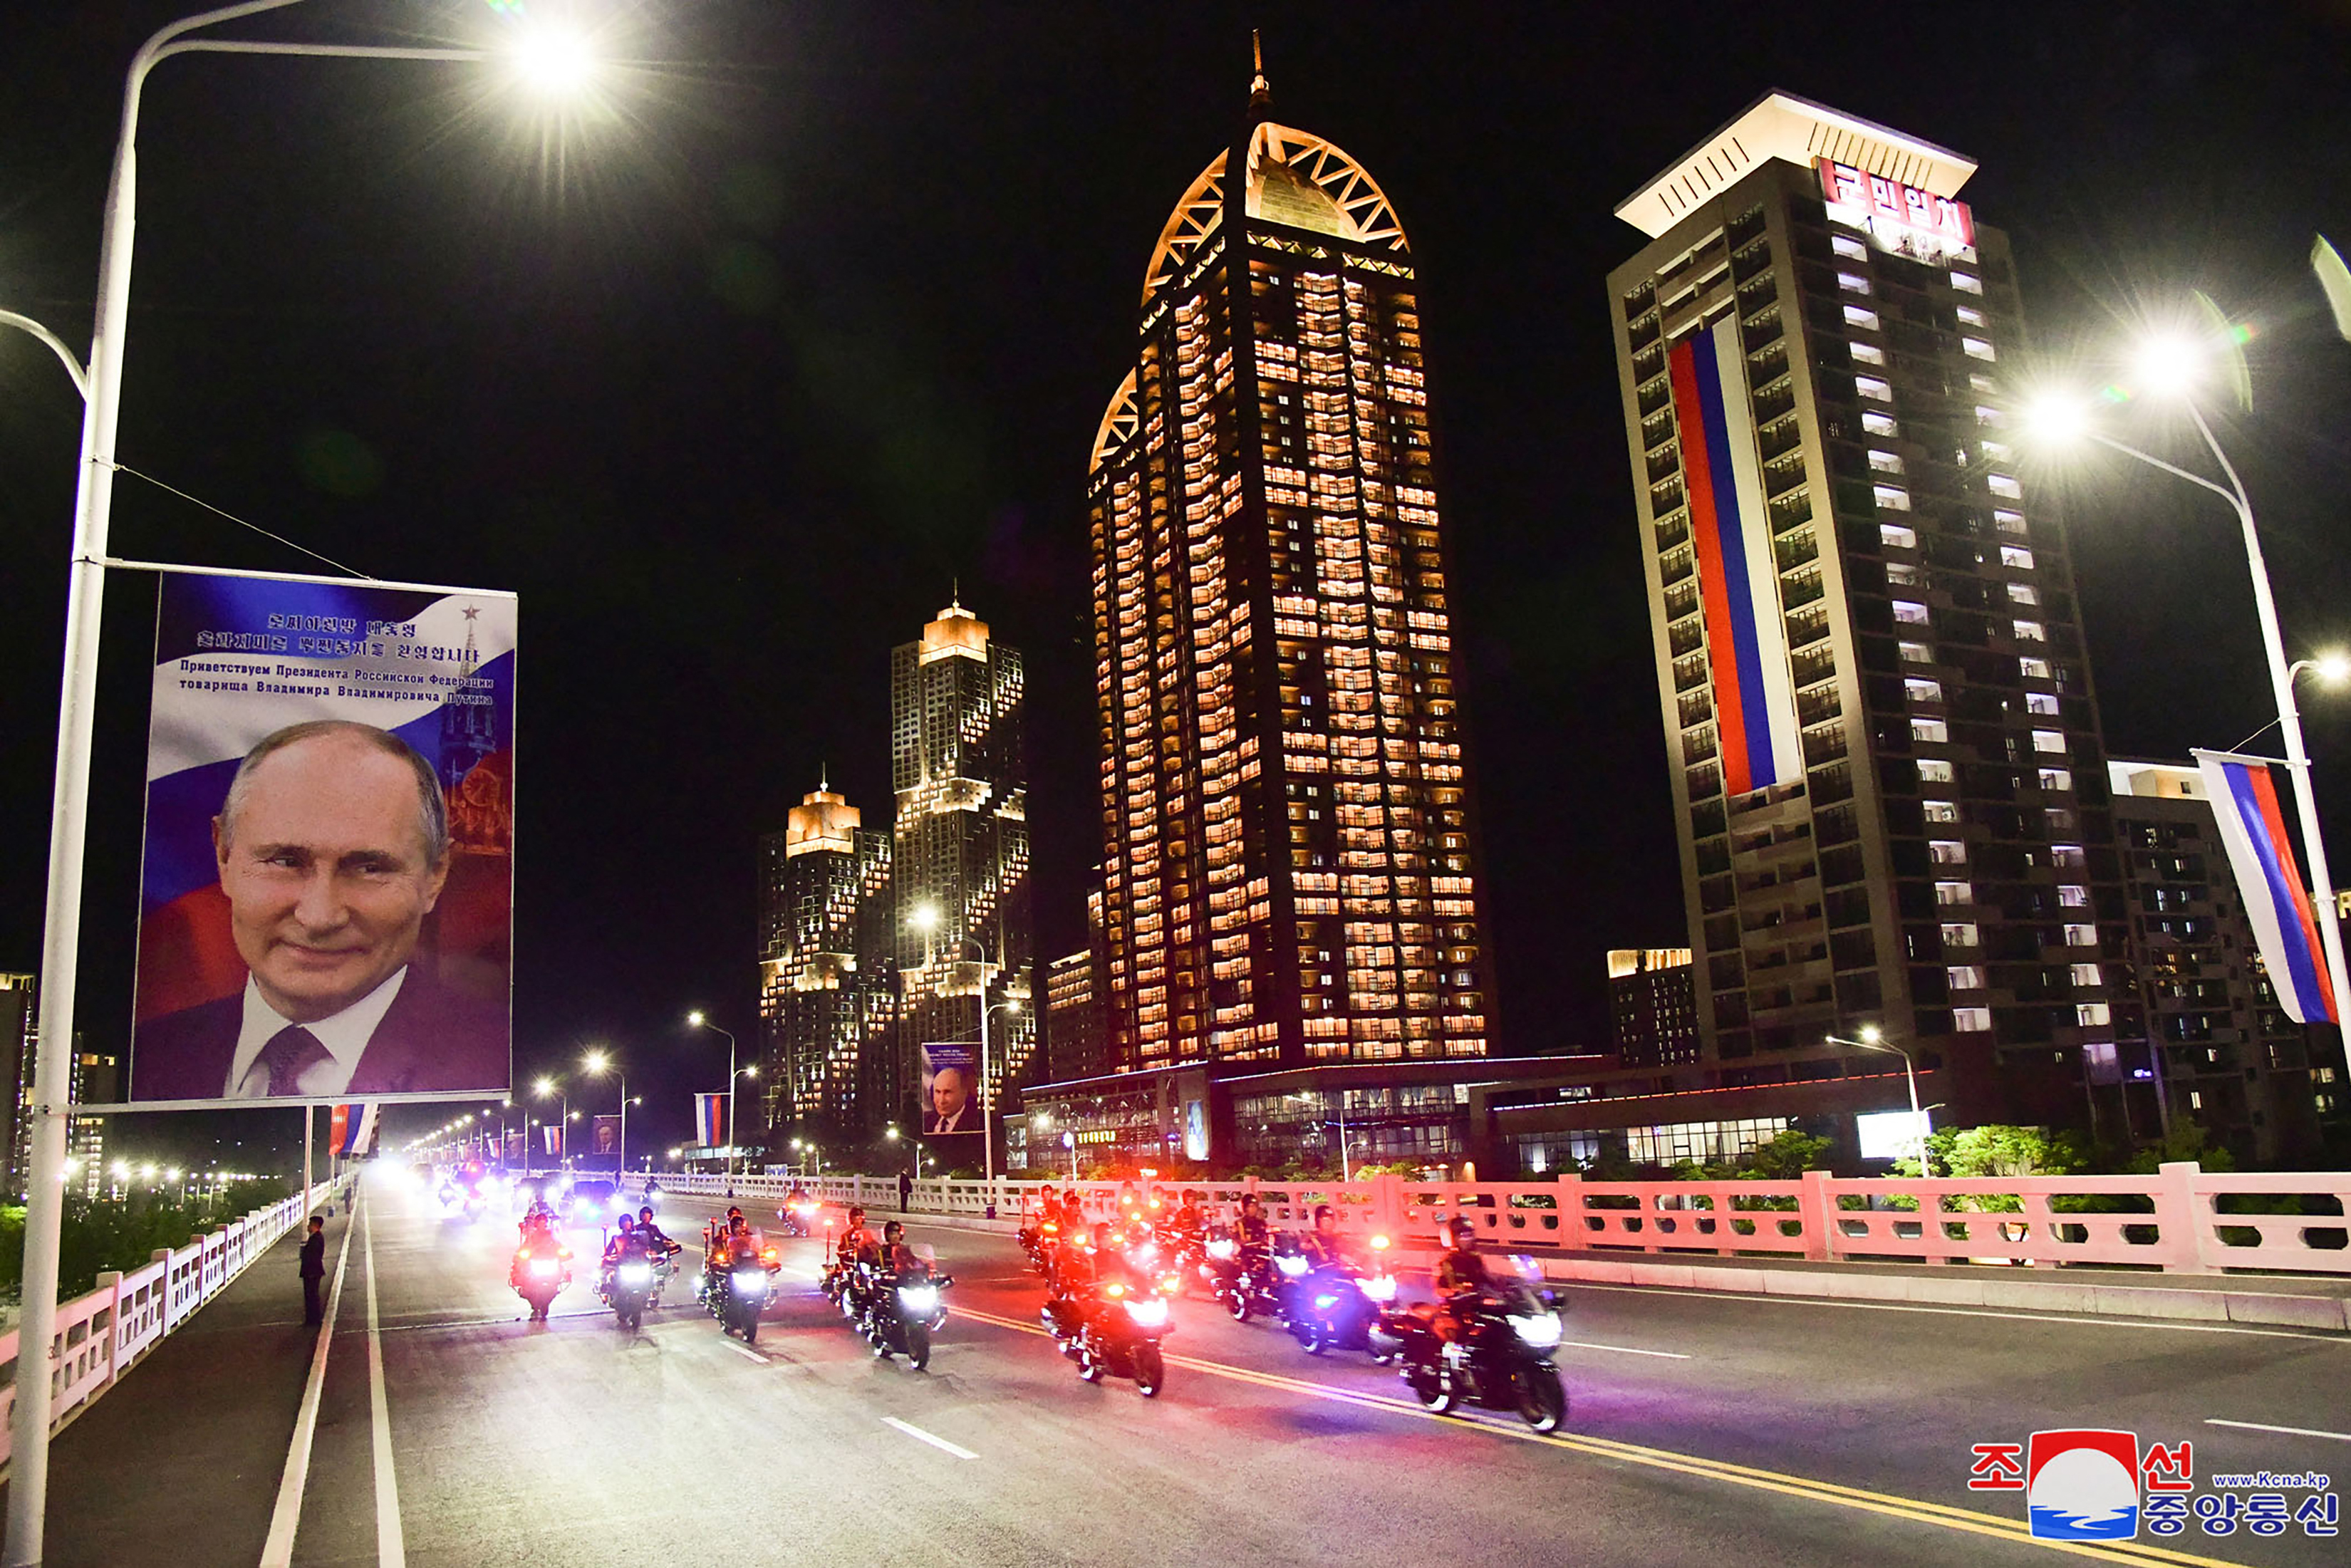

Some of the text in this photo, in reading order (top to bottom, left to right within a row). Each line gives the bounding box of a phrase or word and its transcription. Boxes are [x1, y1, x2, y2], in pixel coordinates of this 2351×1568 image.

[366, 621, 417, 638] 대통령
[397, 643, 480, 663] 환영합니다
[180, 659, 494, 689] Приветствуем Президента Российской Федерации
[180, 680, 494, 706] товарища Владимира Владимировича Путина
